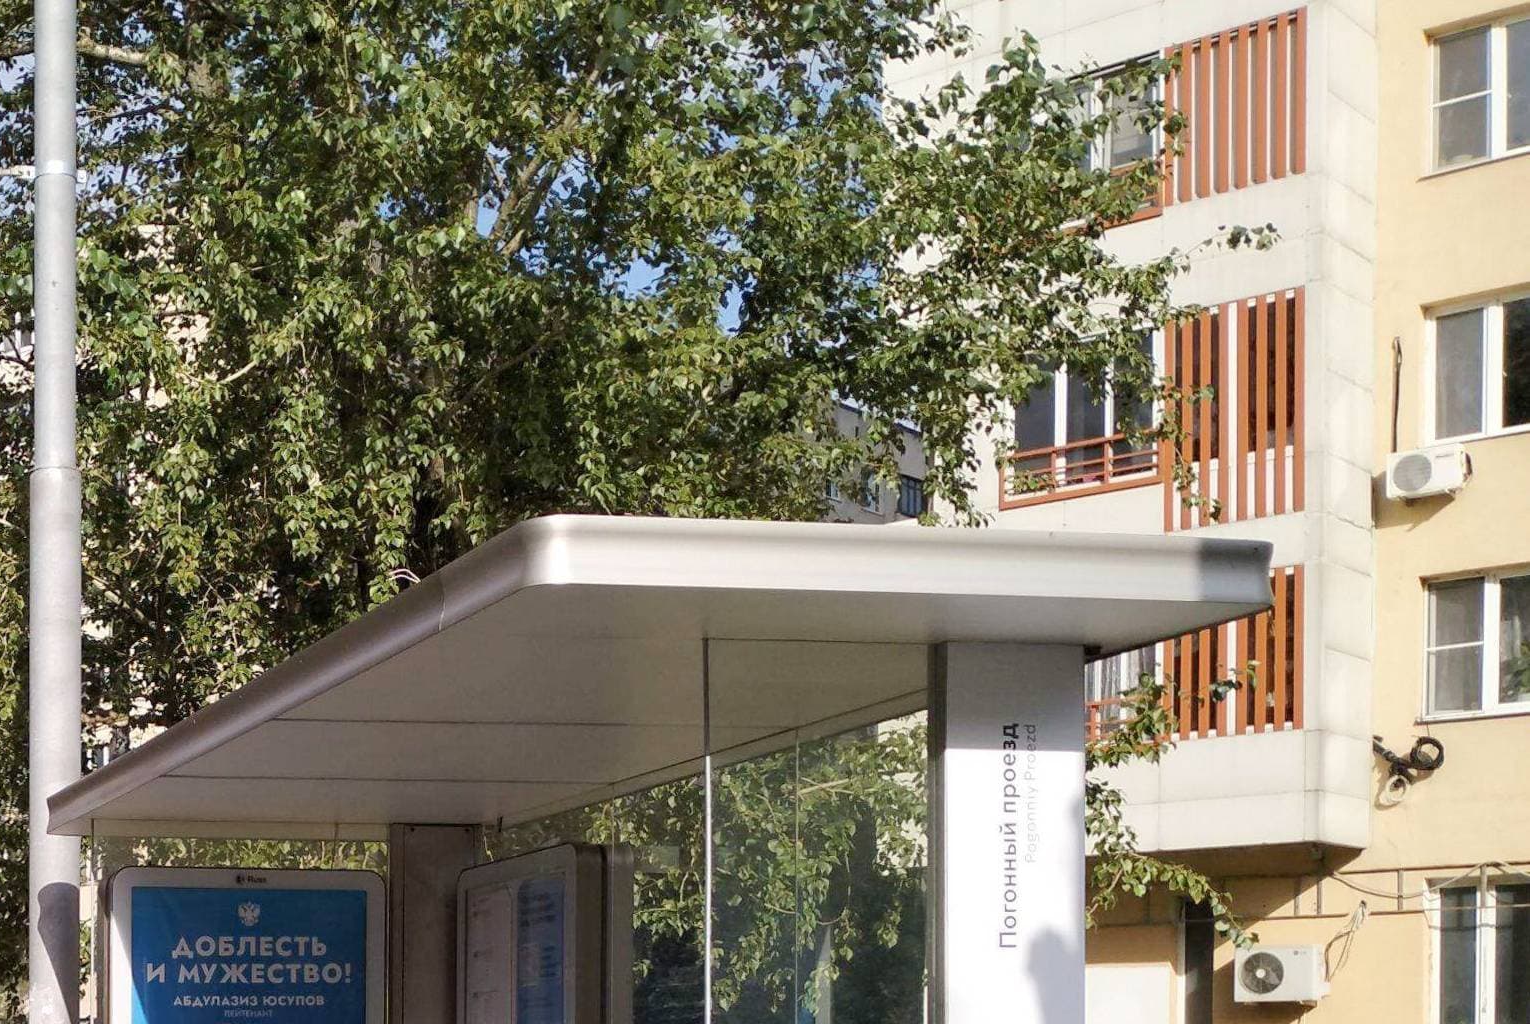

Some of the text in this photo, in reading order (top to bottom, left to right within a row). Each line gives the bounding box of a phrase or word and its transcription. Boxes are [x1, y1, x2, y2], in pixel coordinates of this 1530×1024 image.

[1024, 724, 1037, 781] Proezd
[999, 723, 1020, 948] Погонный проезд
[171, 935, 327, 959] ДОБЛЕСТЬ
[147, 963, 351, 984] И МУЖЕСТВО!
[173, 995, 325, 1007] АБДУЛАЗИЗ ЮСУПОВ
